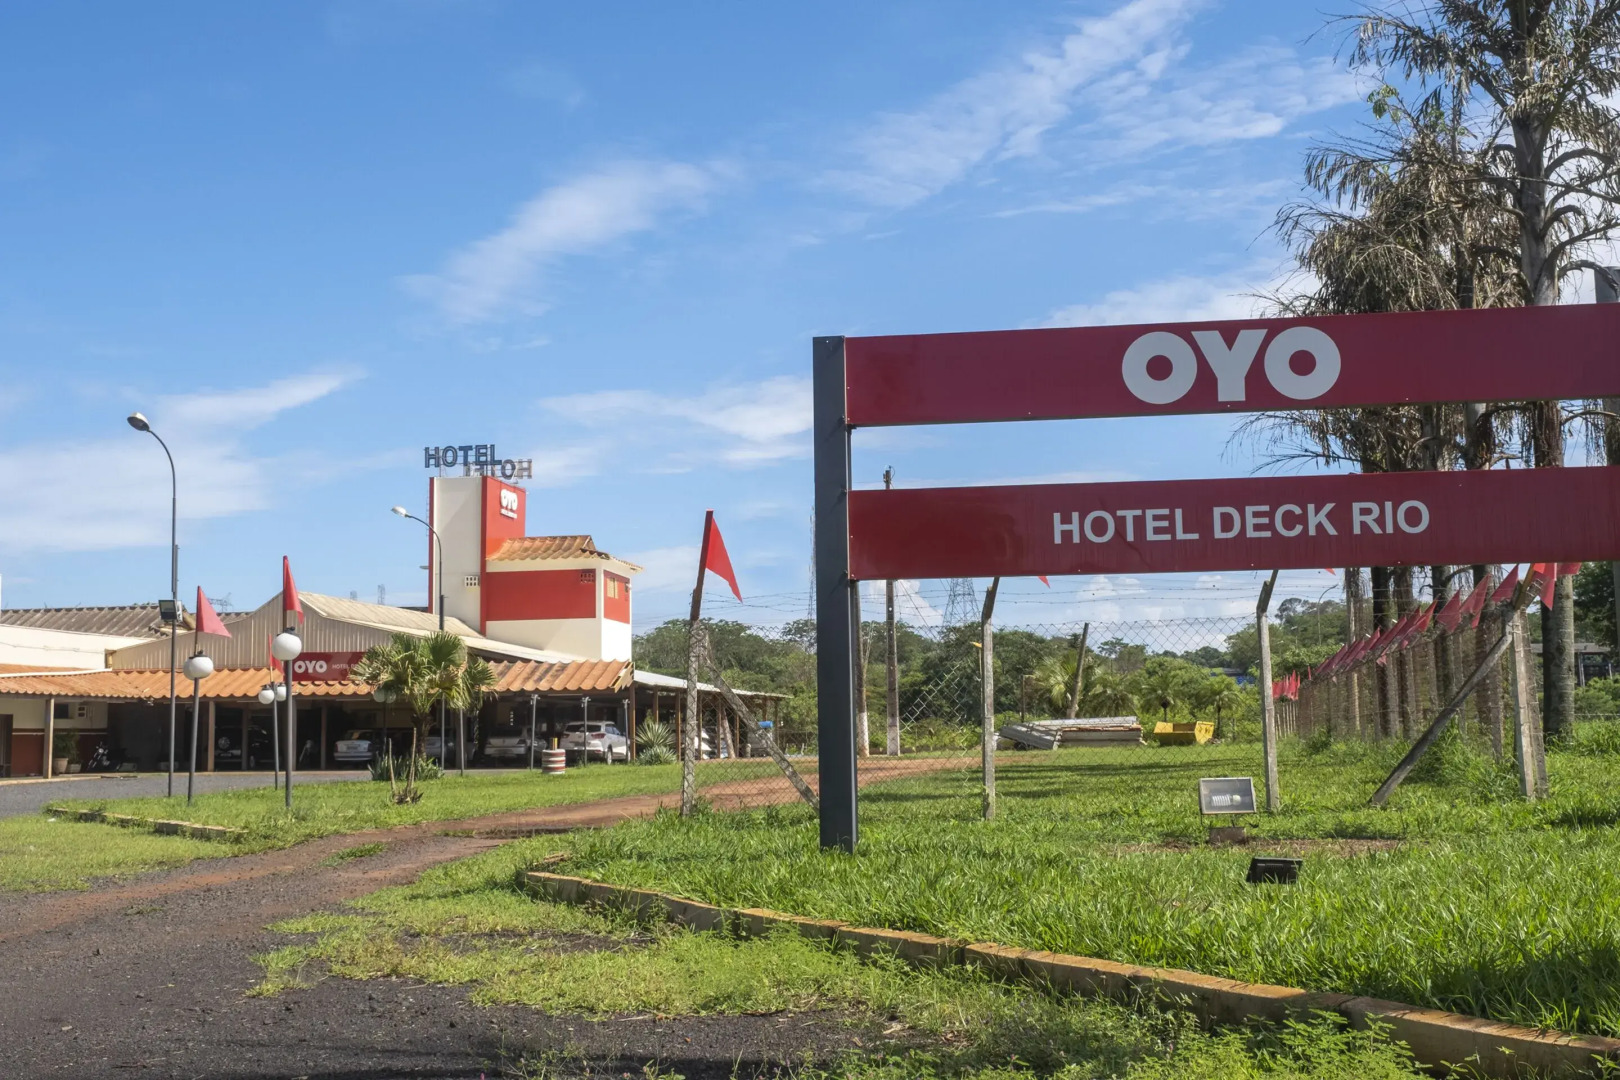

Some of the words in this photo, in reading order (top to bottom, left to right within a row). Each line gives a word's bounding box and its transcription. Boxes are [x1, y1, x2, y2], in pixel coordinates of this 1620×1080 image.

[1122, 325, 1341, 404] OYO
[424, 444, 502, 469] HOTEL
[1053, 508, 1200, 545] HOTEL
[1213, 503, 1338, 539] DECK
[1352, 500, 1431, 535] RIO
[294, 660, 328, 674] OYO
